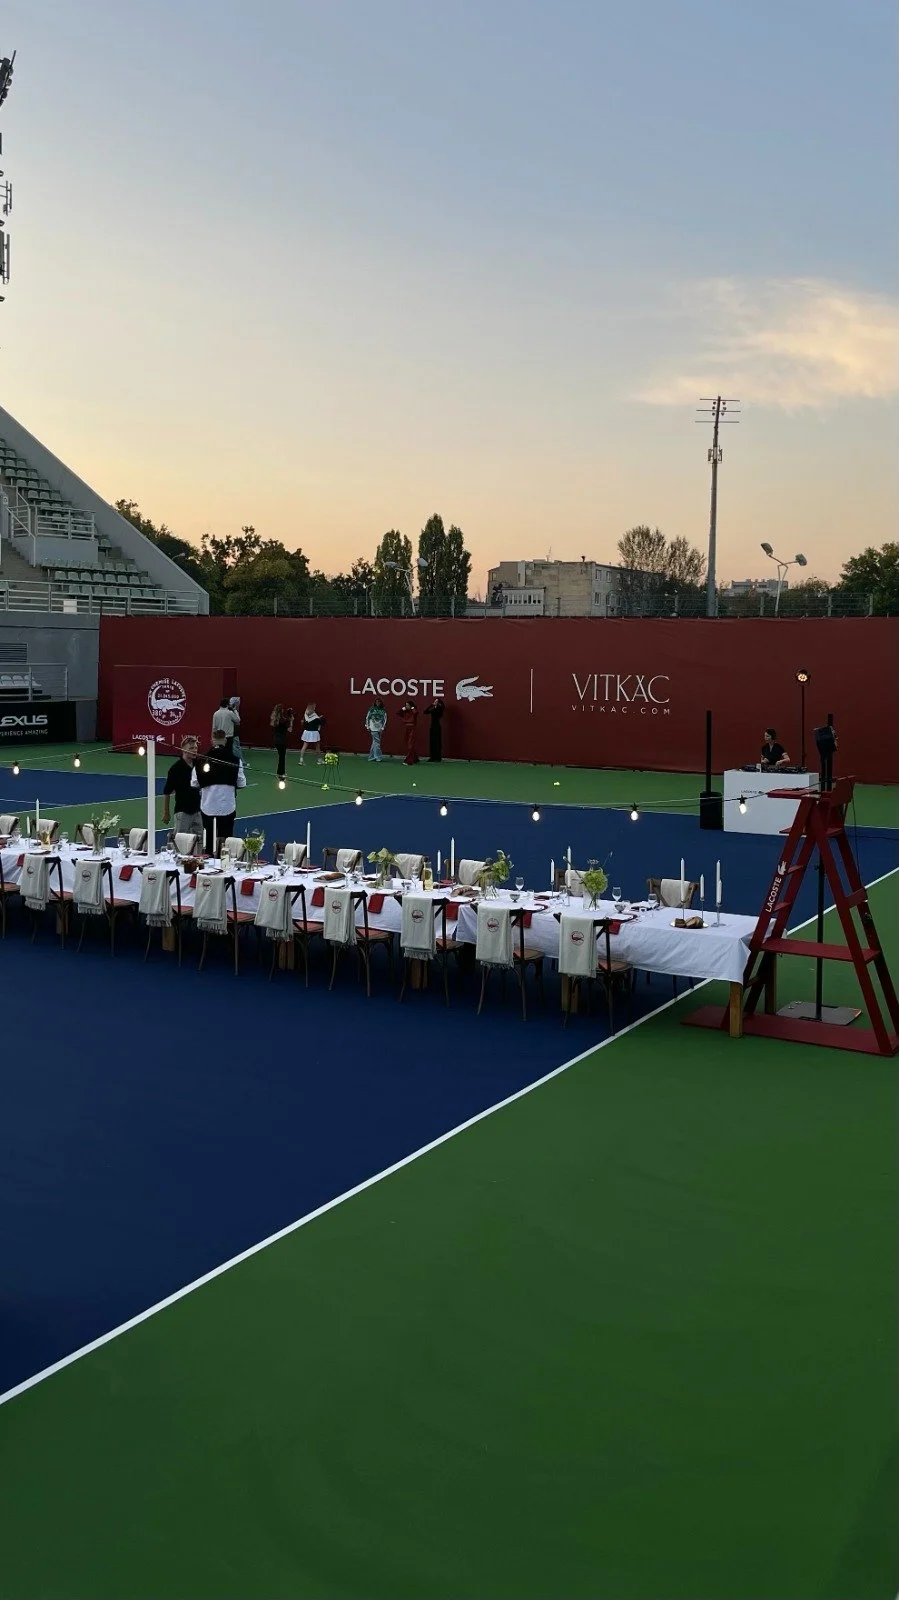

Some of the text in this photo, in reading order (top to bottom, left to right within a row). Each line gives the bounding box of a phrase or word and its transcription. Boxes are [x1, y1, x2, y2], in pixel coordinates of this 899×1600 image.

[350, 677, 445, 697] LACOSTE
[572, 673, 670, 704] VITKAC
[571, 704, 670, 715] VITKAC.COM
[0, 715, 48, 726] EXUS
[765, 876, 782, 913] LACOSTE
